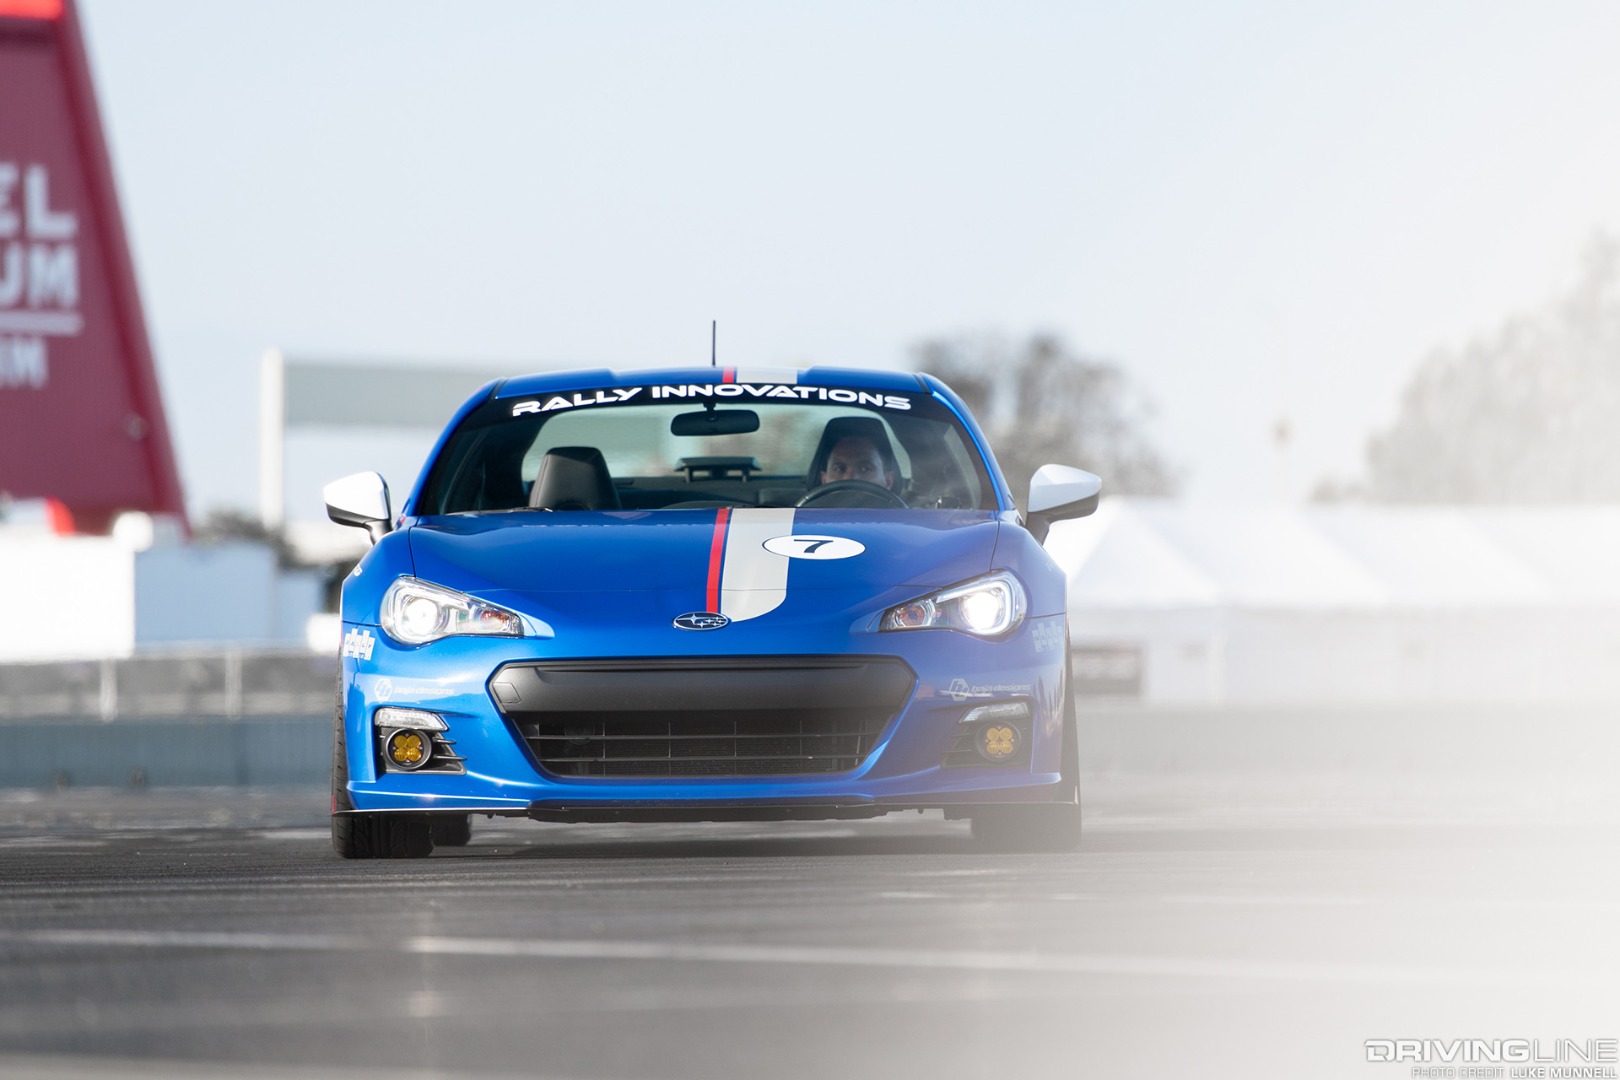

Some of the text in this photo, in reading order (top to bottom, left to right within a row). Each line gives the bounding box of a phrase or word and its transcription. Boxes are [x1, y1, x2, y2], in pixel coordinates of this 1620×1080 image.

[511, 384, 912, 417] RALLY INNOVATIONS
[793, 538, 834, 554] 7
